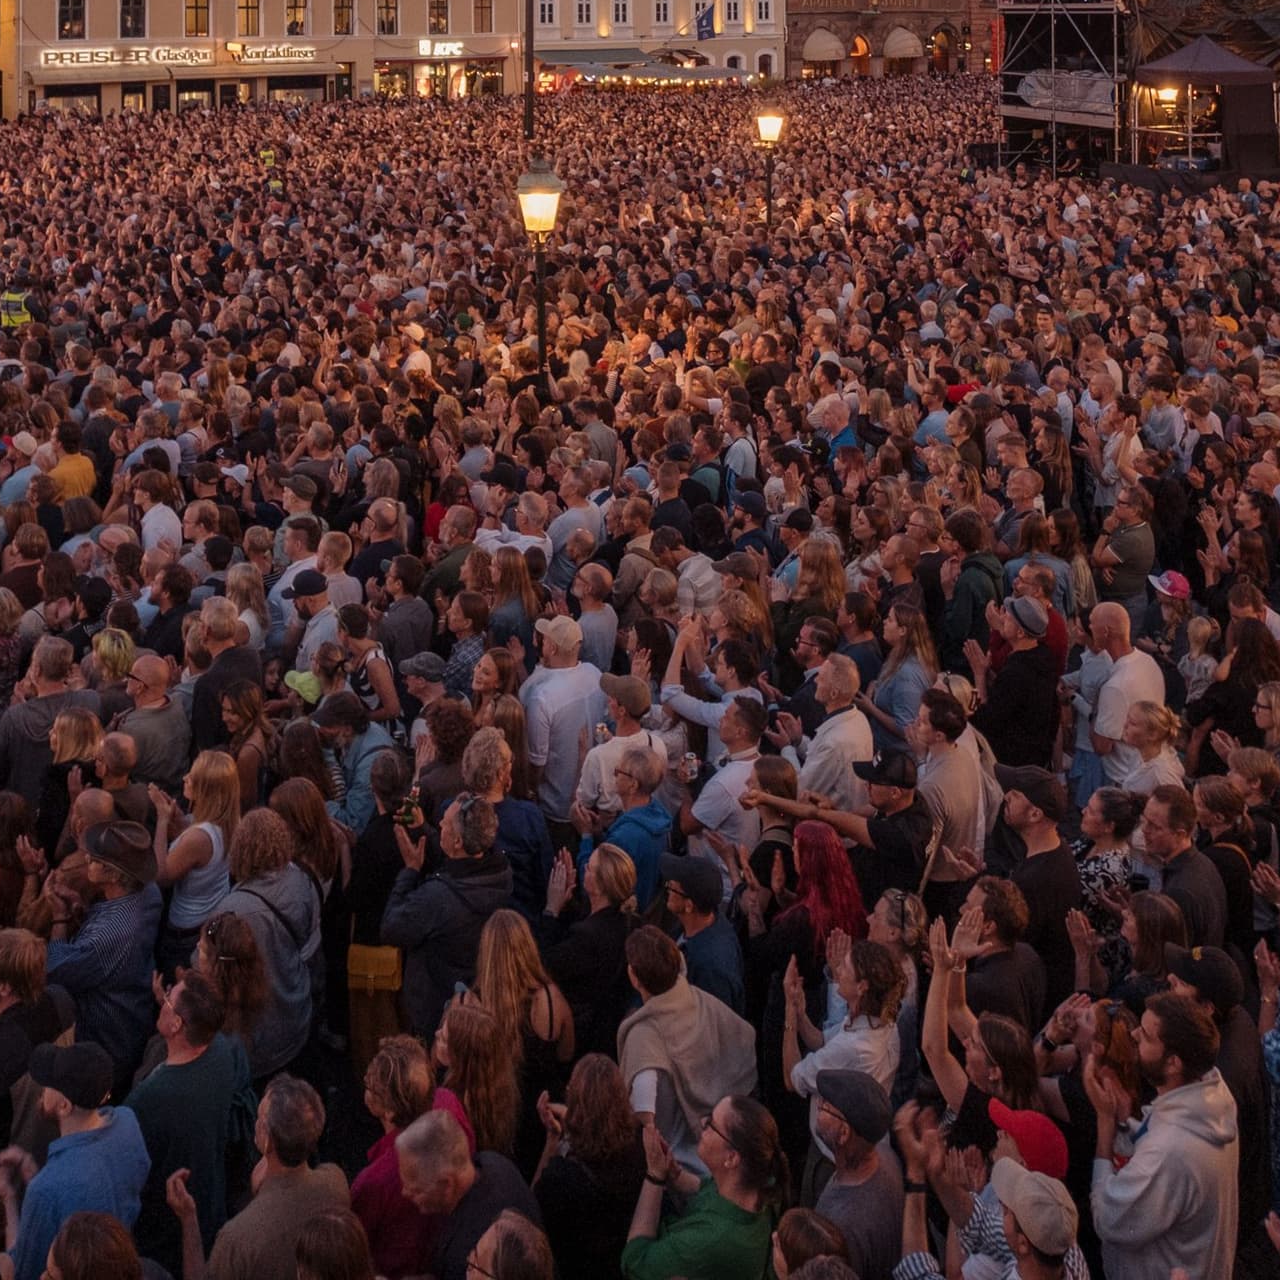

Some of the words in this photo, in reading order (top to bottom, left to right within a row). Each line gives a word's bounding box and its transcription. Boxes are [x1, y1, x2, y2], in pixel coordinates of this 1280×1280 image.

[42, 50, 151, 65] PREISLER
[154, 47, 213, 66] Glasögon
[433, 41, 464, 56] KFC
